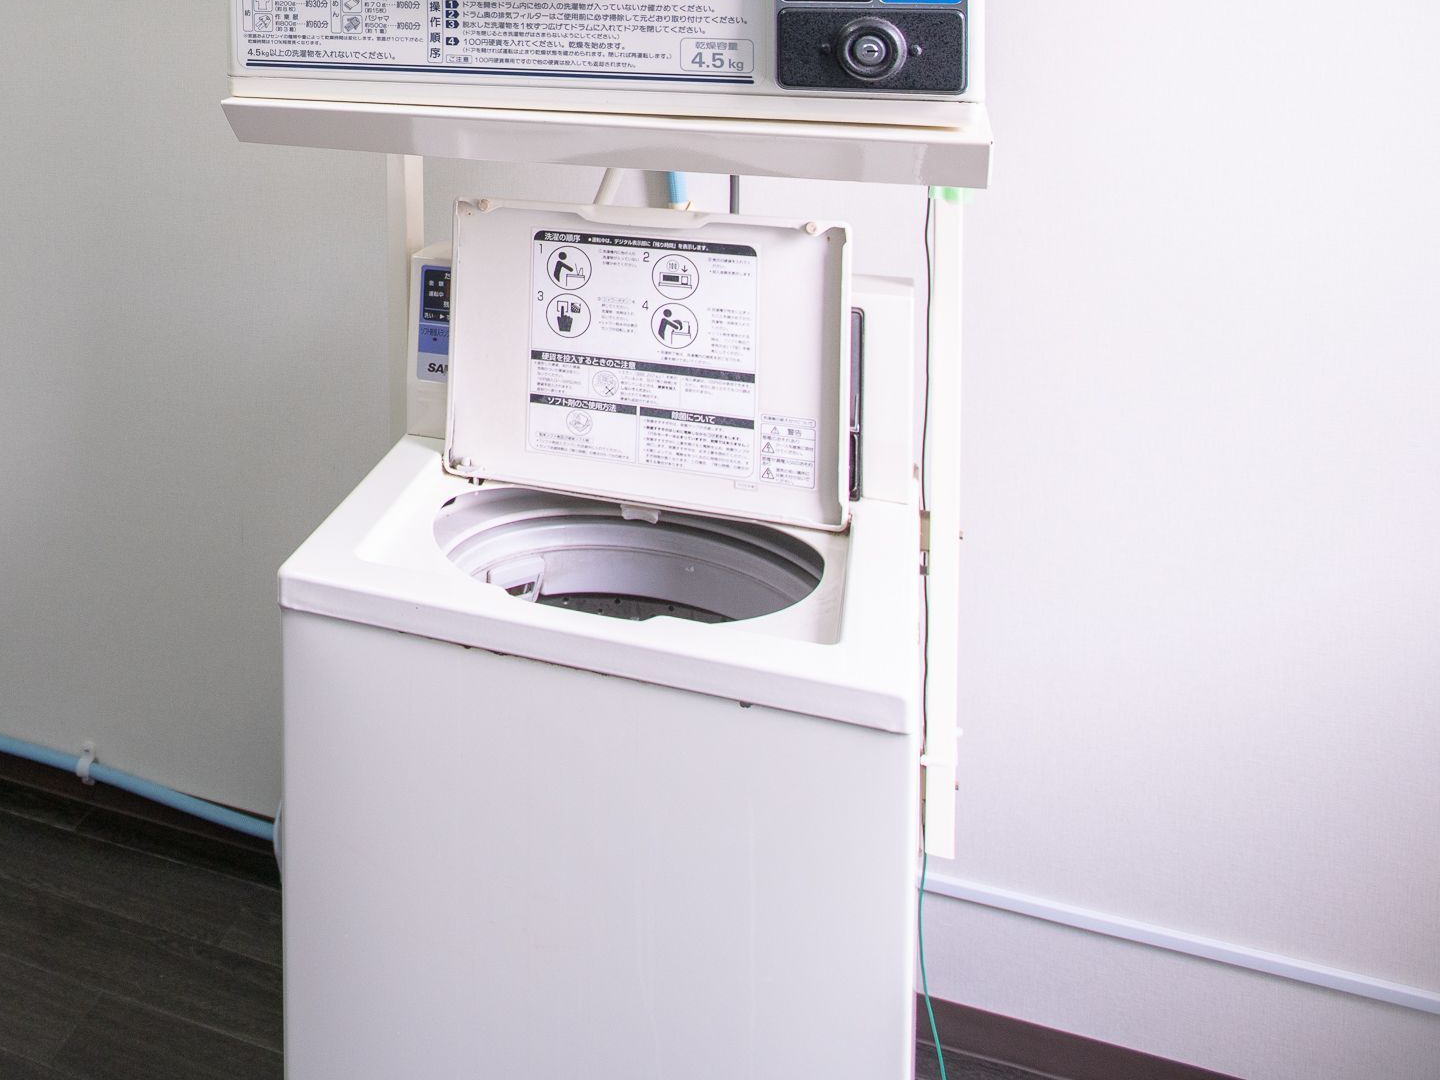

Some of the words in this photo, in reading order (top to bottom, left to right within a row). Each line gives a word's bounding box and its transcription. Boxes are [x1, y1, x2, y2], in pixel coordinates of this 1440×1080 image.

[691, 52, 725, 68] 4.5
[729, 58, 744, 70] kg
[544, 232, 580, 243] 洗濯の順序
[642, 251, 650, 262] 2
[537, 290, 544, 301] 3
[642, 300, 649, 310] 4
